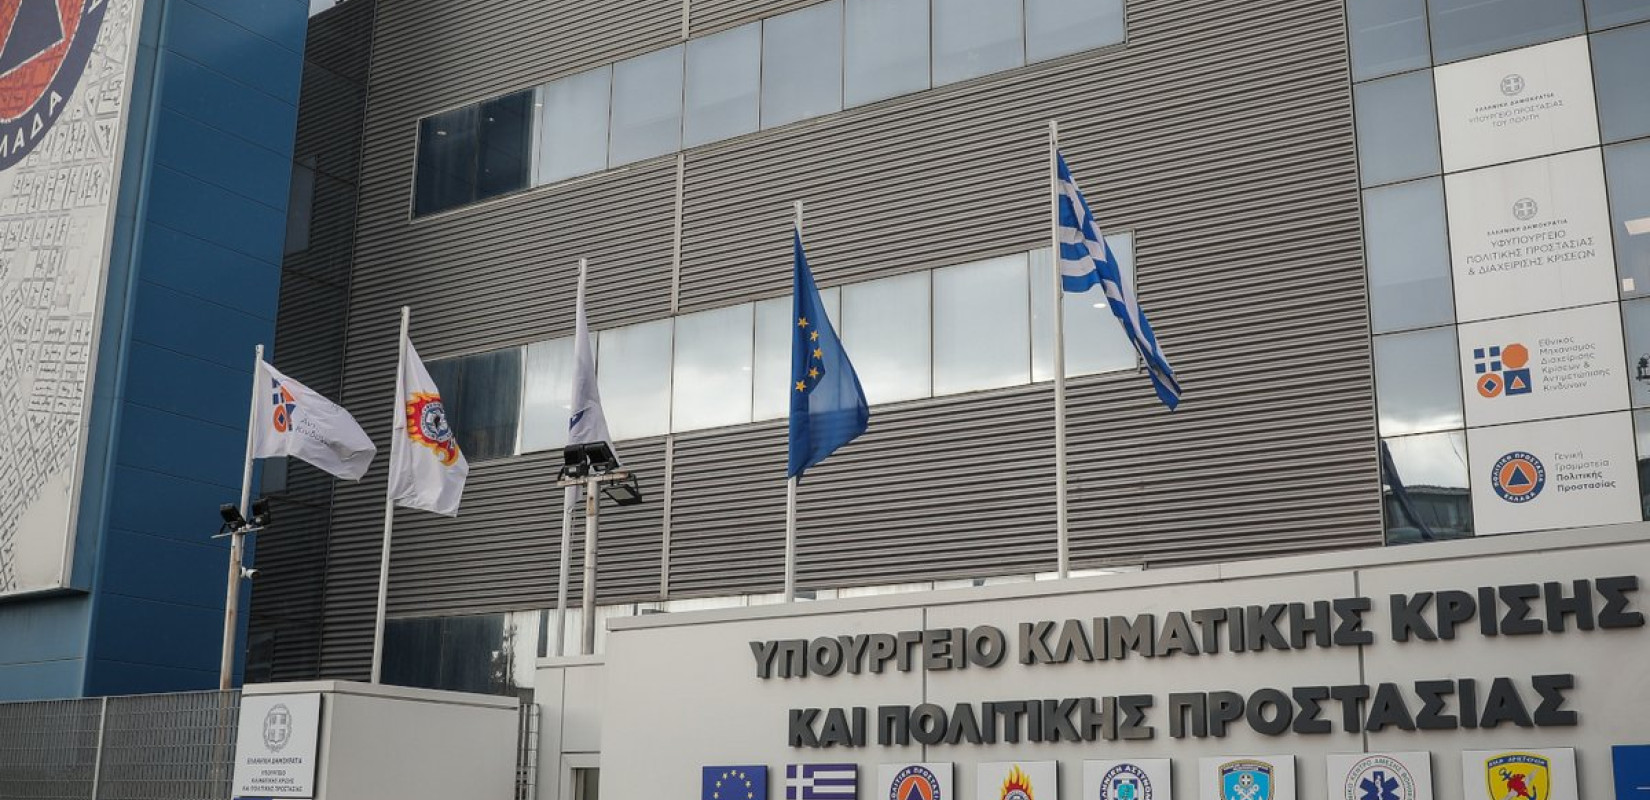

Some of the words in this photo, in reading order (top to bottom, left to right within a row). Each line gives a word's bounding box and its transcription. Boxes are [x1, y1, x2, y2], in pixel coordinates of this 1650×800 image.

[1466, 248, 1522, 264] ΠΟΛΙΤΙΚΗΣ
[1526, 237, 1594, 255] ΠΡΟΣΤΑΣΙΑΣ
[1491, 230, 1566, 248] ΥΦΥΠΟΥΡΓΕΙΟ
[1468, 267, 1475, 275] &
[1479, 257, 1543, 274] ΔΙΑΧΕΙΡΙΣΗΣ
[1547, 249, 1595, 263] ΚΡΙΣΕΩΝ
[749, 625, 1006, 679] ΥΠΟΥΡΓΕΙΟ
[1019, 597, 1373, 665] ΚΛΙΜΑΤΙΚΗΣ
[1390, 575, 1645, 642] ΚΡΙΣΗΣ
[788, 706, 867, 748] ΚΑΙ
[878, 694, 1155, 746] ΠΟΛΙΤΙΚΗΣ
[1169, 674, 1578, 738] ΠΡΟΣΤΑΣΙΑΣ
